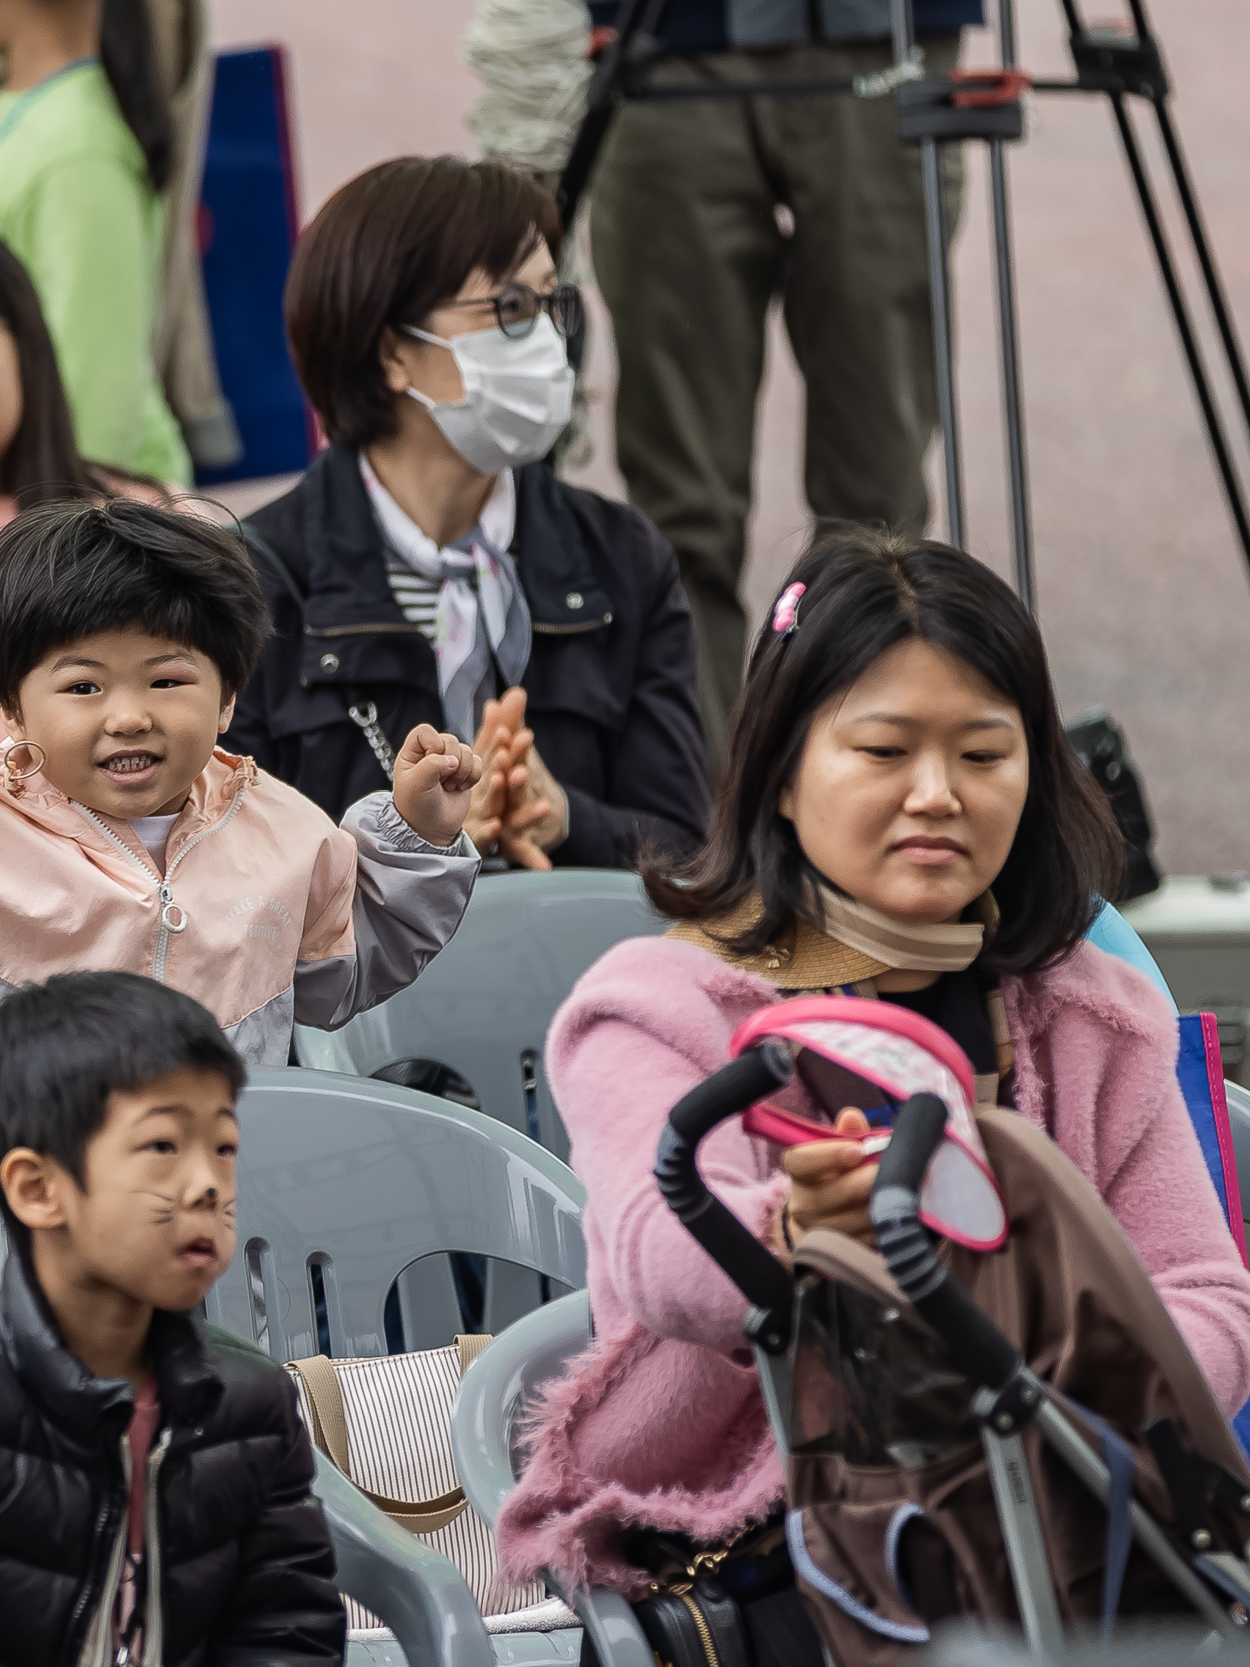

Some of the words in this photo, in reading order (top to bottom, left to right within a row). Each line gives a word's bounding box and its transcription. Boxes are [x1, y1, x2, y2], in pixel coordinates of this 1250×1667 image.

[225, 897, 254, 924] MAKE
[257, 895, 265, 908] A
[268, 898, 292, 928] GREAT
[243, 923, 278, 941] POSITIVE
